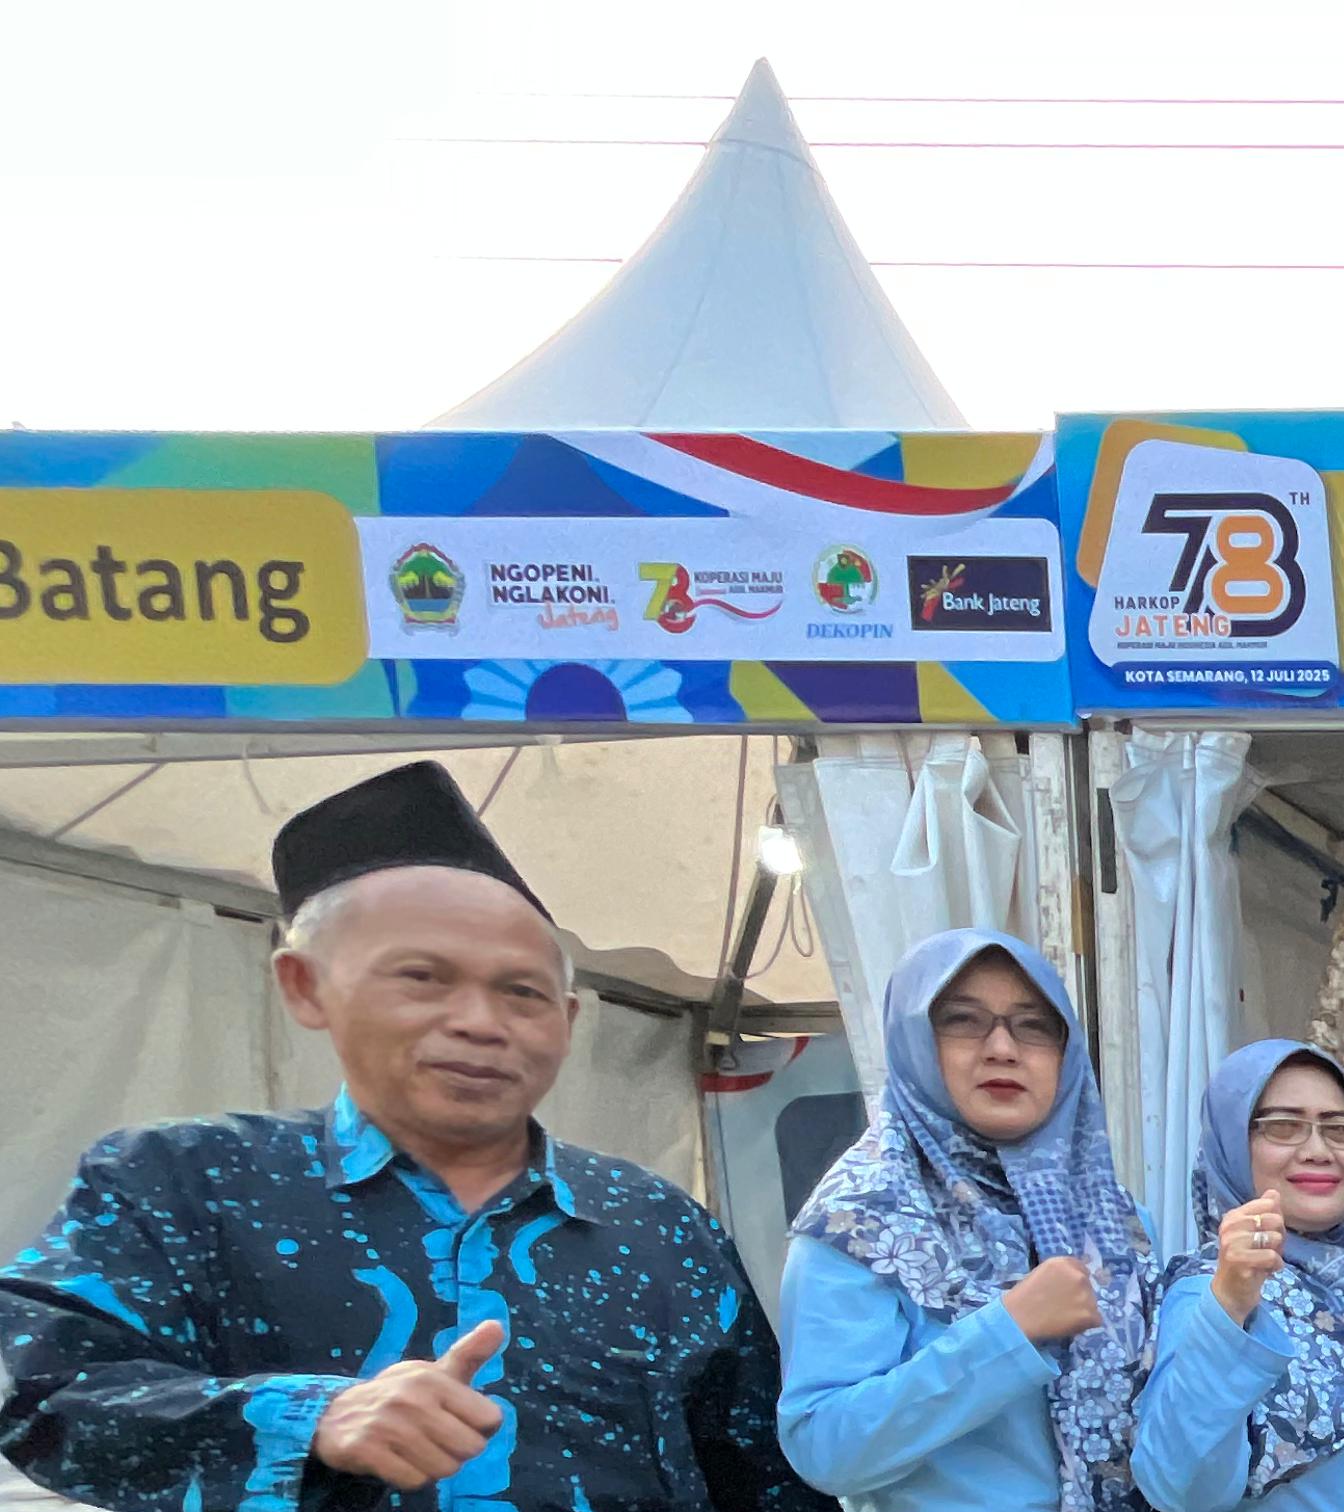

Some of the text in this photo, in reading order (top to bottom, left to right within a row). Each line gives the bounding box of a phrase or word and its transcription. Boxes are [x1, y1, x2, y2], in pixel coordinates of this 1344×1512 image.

[1289, 492, 1310, 505] TH
[490, 563, 600, 583] NGOPENI.
[1141, 492, 1307, 637] 78
[0, 539, 310, 643] Batang
[492, 585, 616, 605] NGLAKONI.
[943, 592, 1041, 617] Bank Jateng
[1114, 596, 1181, 610] HARKOP
[806, 623, 894, 640] DEKOPIN
[1115, 614, 1232, 637] JATENG
[1125, 669, 1331, 684] KOTA SEMARANG, 12 JULI 2025
